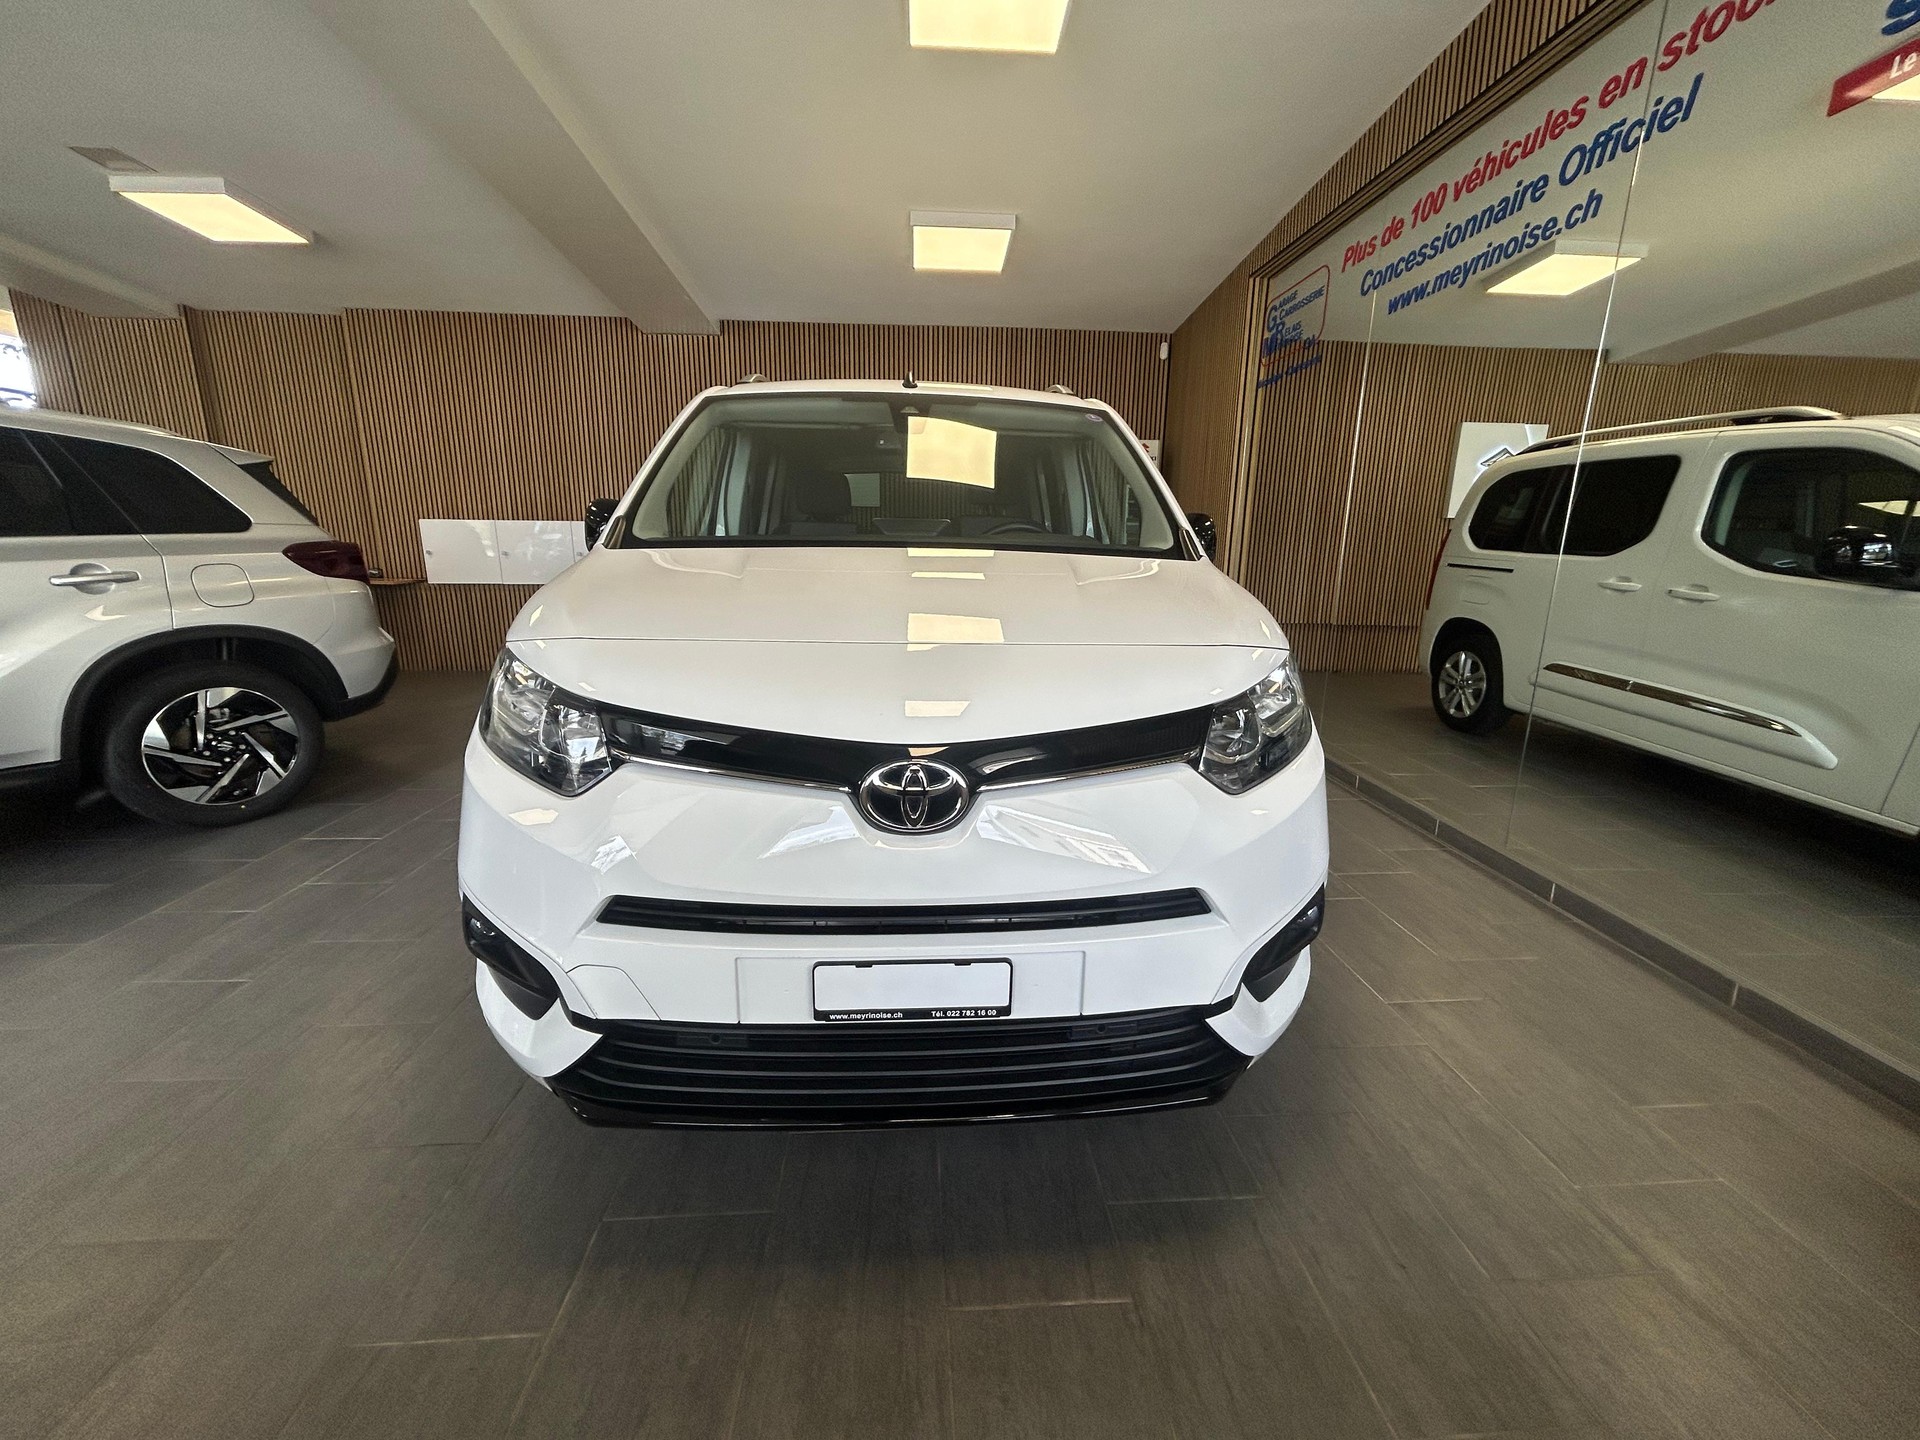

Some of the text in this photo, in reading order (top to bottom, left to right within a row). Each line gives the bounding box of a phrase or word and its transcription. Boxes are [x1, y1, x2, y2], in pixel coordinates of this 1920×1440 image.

[1889, 53, 1918, 79] Le
[1341, 0, 1775, 273] Plus de 100 véhicules en sto
[1360, 72, 1705, 297] Concessionnaire Officiel
[1387, 188, 1604, 315] www.meyrinoise.ch
[829, 1011, 903, 1020] www.meyrinoise.ch
